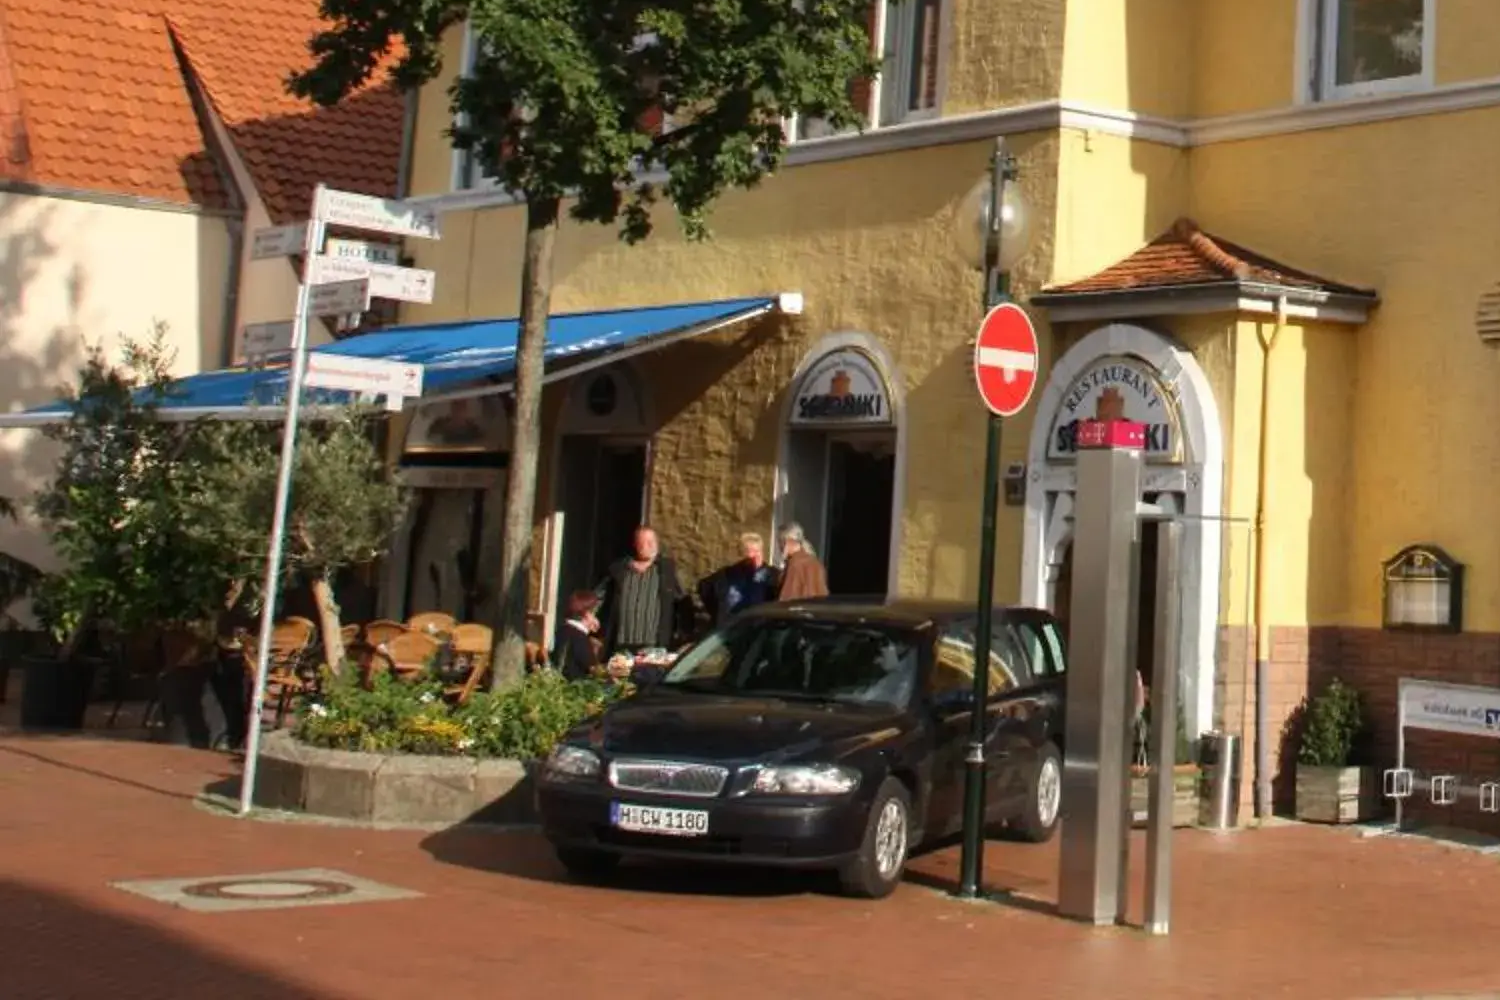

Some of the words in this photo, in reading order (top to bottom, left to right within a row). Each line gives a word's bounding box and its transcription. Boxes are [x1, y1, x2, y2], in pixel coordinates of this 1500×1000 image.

[336, 244, 390, 262] HOTEL
[1065, 365, 1161, 413] RESTAURANT
[621, 807, 632, 823] H
